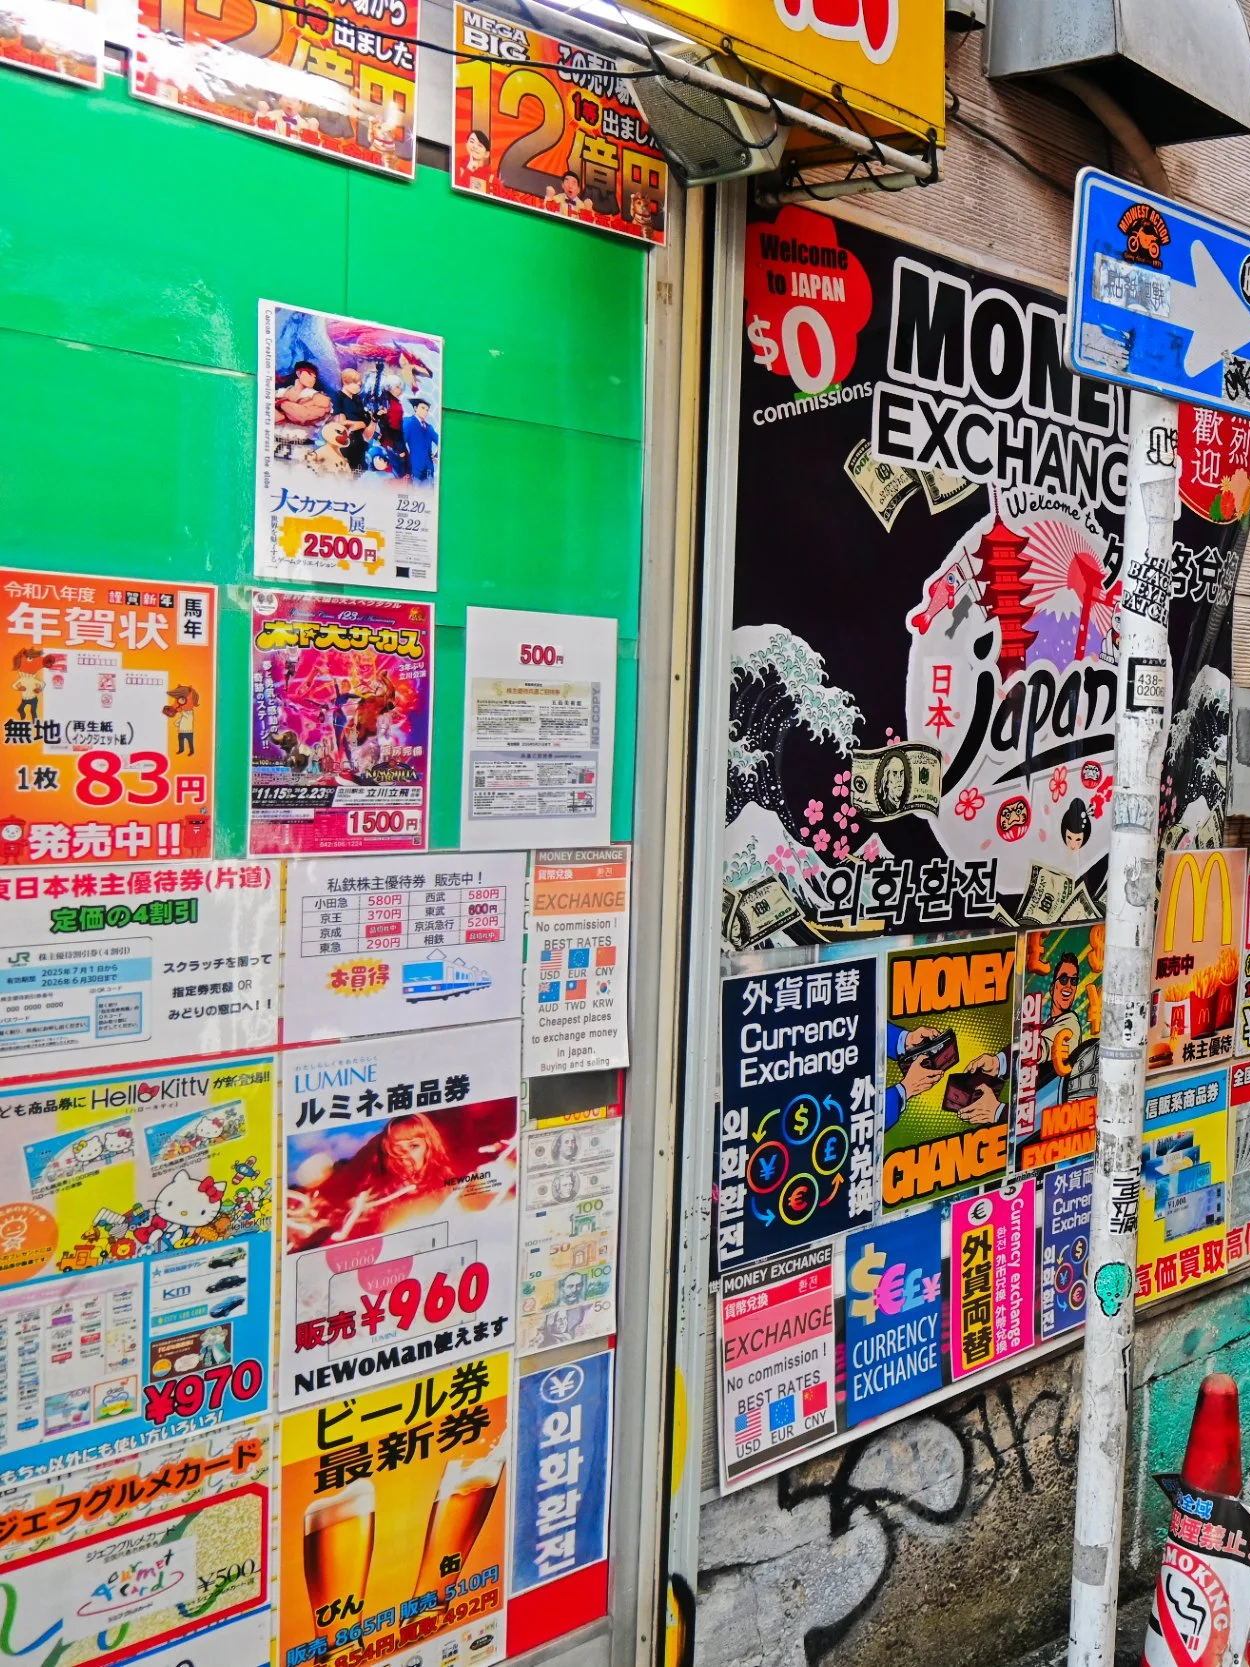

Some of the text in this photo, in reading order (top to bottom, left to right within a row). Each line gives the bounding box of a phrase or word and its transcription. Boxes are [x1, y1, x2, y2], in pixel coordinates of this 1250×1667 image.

[334, 17, 415, 71] 出ました
[463, 10, 530, 46] MEGA
[463, 27, 530, 61] BIG
[1119, 203, 1170, 244] MIDWEST ACTION
[760, 232, 848, 271] Welcome
[766, 269, 846, 303] to JAPAN
[748, 305, 837, 396] $0
[752, 381, 873, 427] commissions
[873, 381, 1132, 512] EXCHANG
[270, 487, 367, 518] 大カプコン
[395, 499, 426, 514] 12.20
[1005, 489, 1100, 536] Welcome to
[395, 517, 422, 533] 2.22
[304, 533, 377, 563] 2500円
[4, 580, 97, 604] 令和八年度
[7, 601, 169, 651] 年賀状
[184, 598, 203, 640] 馬年
[255, 619, 424, 661] 木下大サーカス
[520, 643, 565, 667] 500円
[924, 663, 957, 740] 日本
[4, 718, 62, 745] 無地
[18, 767, 59, 791] 1枚
[75, 750, 207, 808] 83円
[29, 821, 182, 861] 発売中!!
[349, 810, 420, 834] 1500円
[538, 849, 624, 862] MONEY EXCHANGE
[314, 888, 500, 911] 小田急 580円 580円
[327, 871, 484, 892] 私鉄株主優待券 販売中!
[534, 890, 626, 911] EXCHANGE
[818, 857, 1000, 929] 외화환전
[50, 897, 199, 934] 定価の4割引
[319, 907, 402, 925] 京王 370円
[319, 915, 500, 940] 京成 京浜急行 520円
[536, 919, 611, 932] No commission
[319, 933, 446, 954] 東急 290円 相鉄
[544, 936, 613, 950] BEST RATES
[329, 962, 391, 992] お買得
[540, 966, 616, 981] USD EUR CNY
[892, 950, 1016, 1017] MONEY
[1155, 953, 1195, 980] 販売中
[538, 998, 615, 1014] AUD TWD KRW
[742, 968, 860, 1016] 外貨両替
[532, 1028, 618, 1046] to exchange money
[539, 1012, 612, 1028] Cheapest places
[740, 1015, 859, 1055] Currency
[541, 1060, 565, 1073] Buying
[567, 1045, 597, 1060] japan.
[740, 1044, 859, 1089] Exchange
[1016, 993, 1043, 1136] 외화환전
[1182, 1035, 1233, 1063] 株主優待
[160, 1077, 210, 1101] Kitty
[294, 1063, 378, 1094] LUMINE
[296, 1074, 471, 1128] ルミネ商品券
[1041, 1095, 1097, 1141] MONE
[1145, 1082, 1220, 1121] 信販系商品券
[719, 1106, 749, 1262] 외화환전
[881, 1123, 1008, 1205] CHANGE
[723, 1249, 832, 1296] MONEY EXCHANGE
[1005, 1198, 1024, 1348] Currency exchange
[1136, 1239, 1225, 1298] 高価買取
[962, 1230, 993, 1367] 外貨両替
[725, 1304, 833, 1364] EXCHANGE
[852, 1312, 938, 1370] CURRENCY
[294, 1316, 510, 1396] NEWoMan使えます
[726, 1351, 820, 1395] No commission
[852, 1345, 938, 1402] EXCHANGE
[144, 1358, 264, 1426] ¥970
[316, 1360, 490, 1451] ビール券
[737, 1369, 821, 1416] BEST RATES
[313, 1407, 492, 1494] 最新券
[735, 1410, 827, 1459] USD EUR CNY
[0, 1442, 258, 1542] ジェフグルメカード
[533, 1403, 585, 1578] 외화환전
[196, 1558, 262, 1593] ¥500
[439, 1553, 462, 1578] 缶
[286, 1564, 500, 1667] 販売 865円 販売 510円
[315, 1593, 365, 1628] びん
[443, 1588, 499, 1626] 492円
